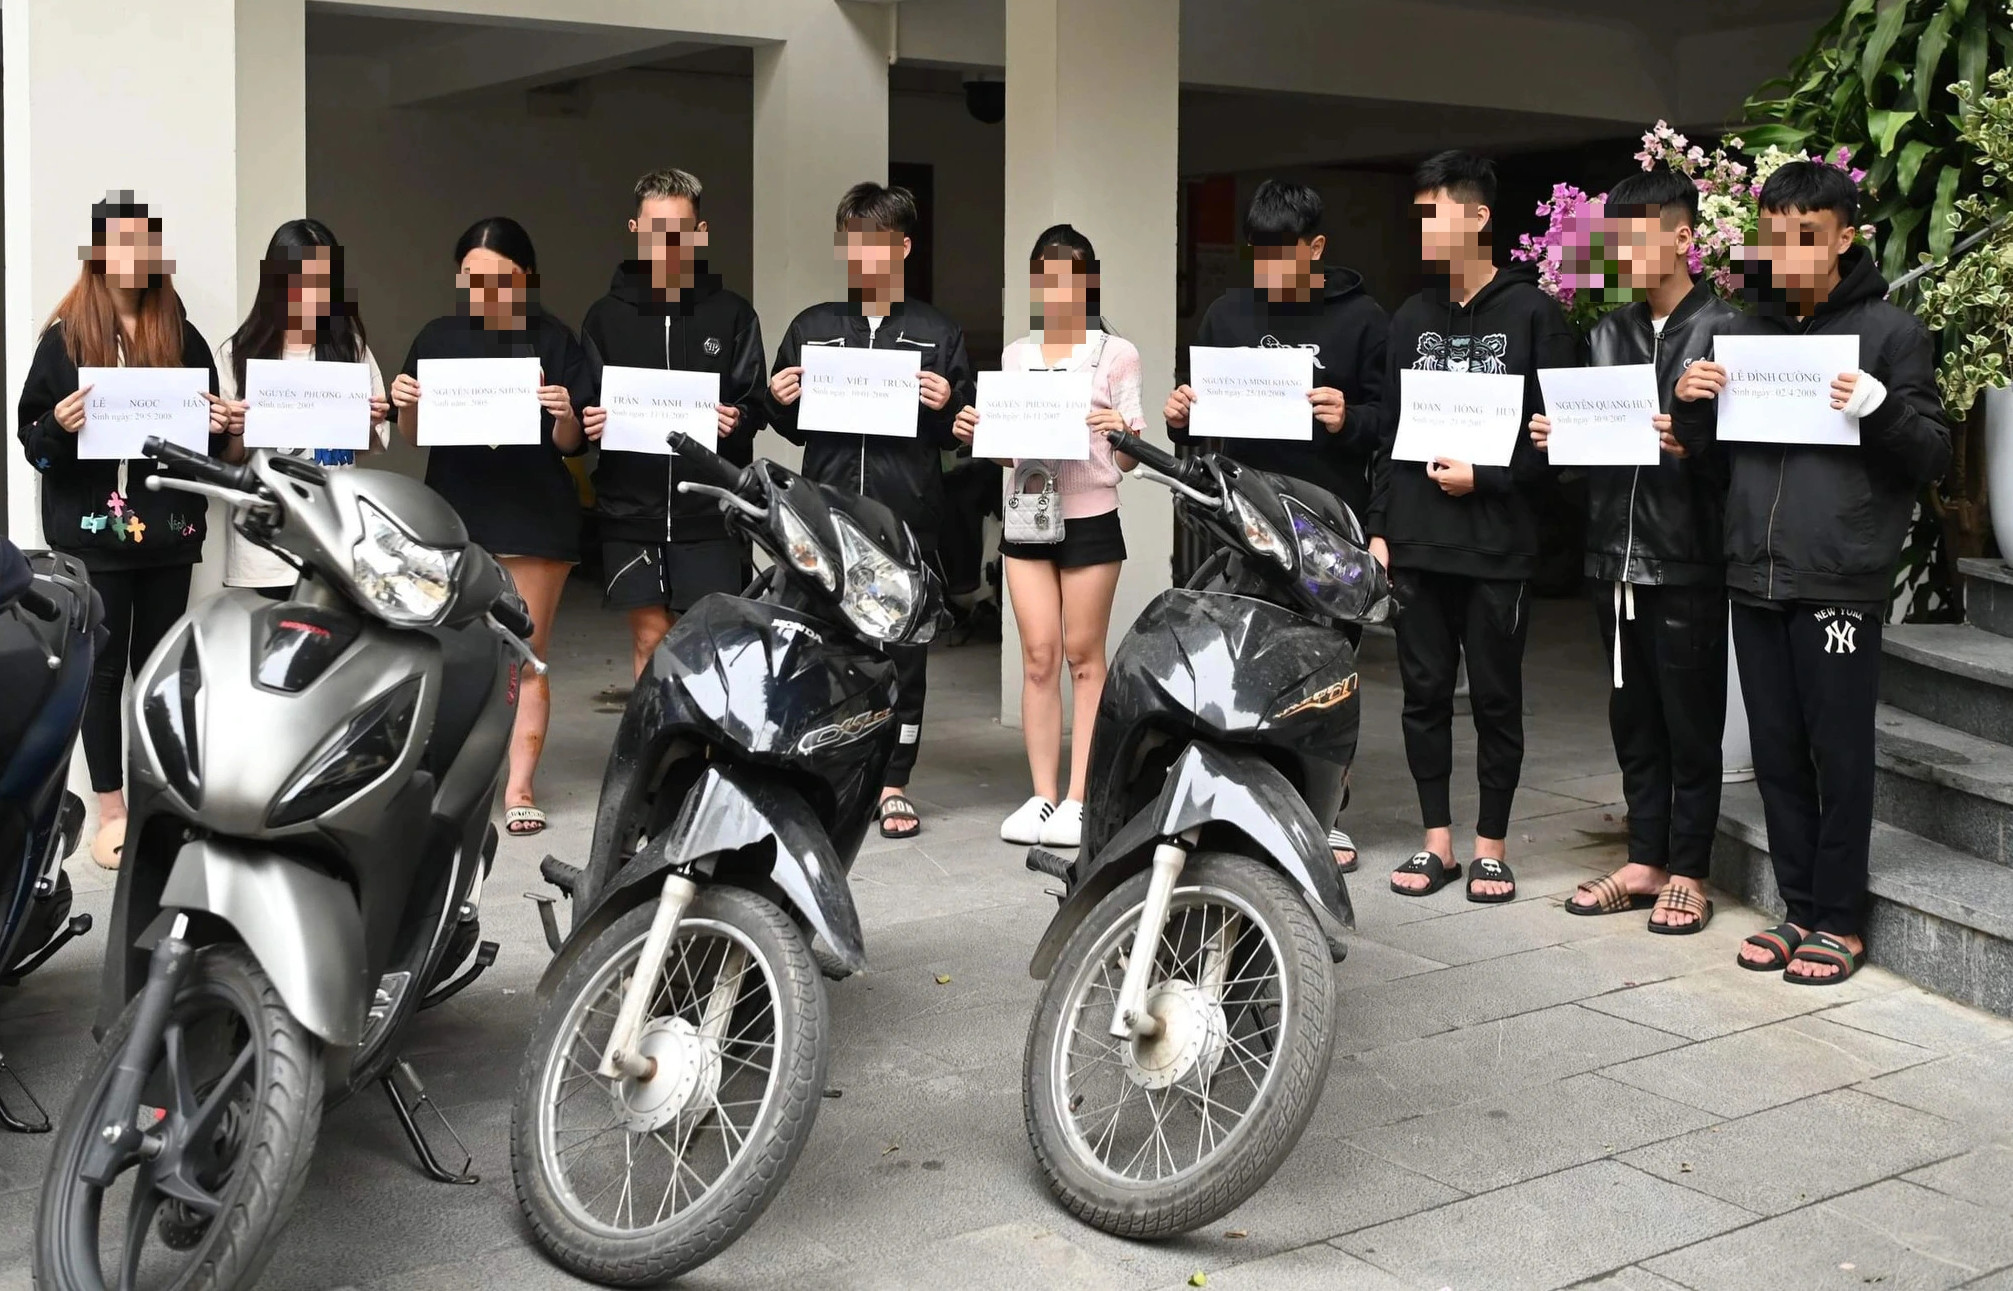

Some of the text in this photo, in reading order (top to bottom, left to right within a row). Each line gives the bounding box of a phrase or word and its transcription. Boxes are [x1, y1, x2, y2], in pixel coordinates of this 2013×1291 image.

[1206, 388, 1223, 397] Sinh
[1732, 387, 1749, 397] Sinh
[1596, 400, 1631, 411] QUANG
[1632, 399, 1655, 409] HUY
[92, 412, 110, 421] Sinh
[1814, 607, 1836, 622] NEW
[771, 618, 823, 644] HONDA
